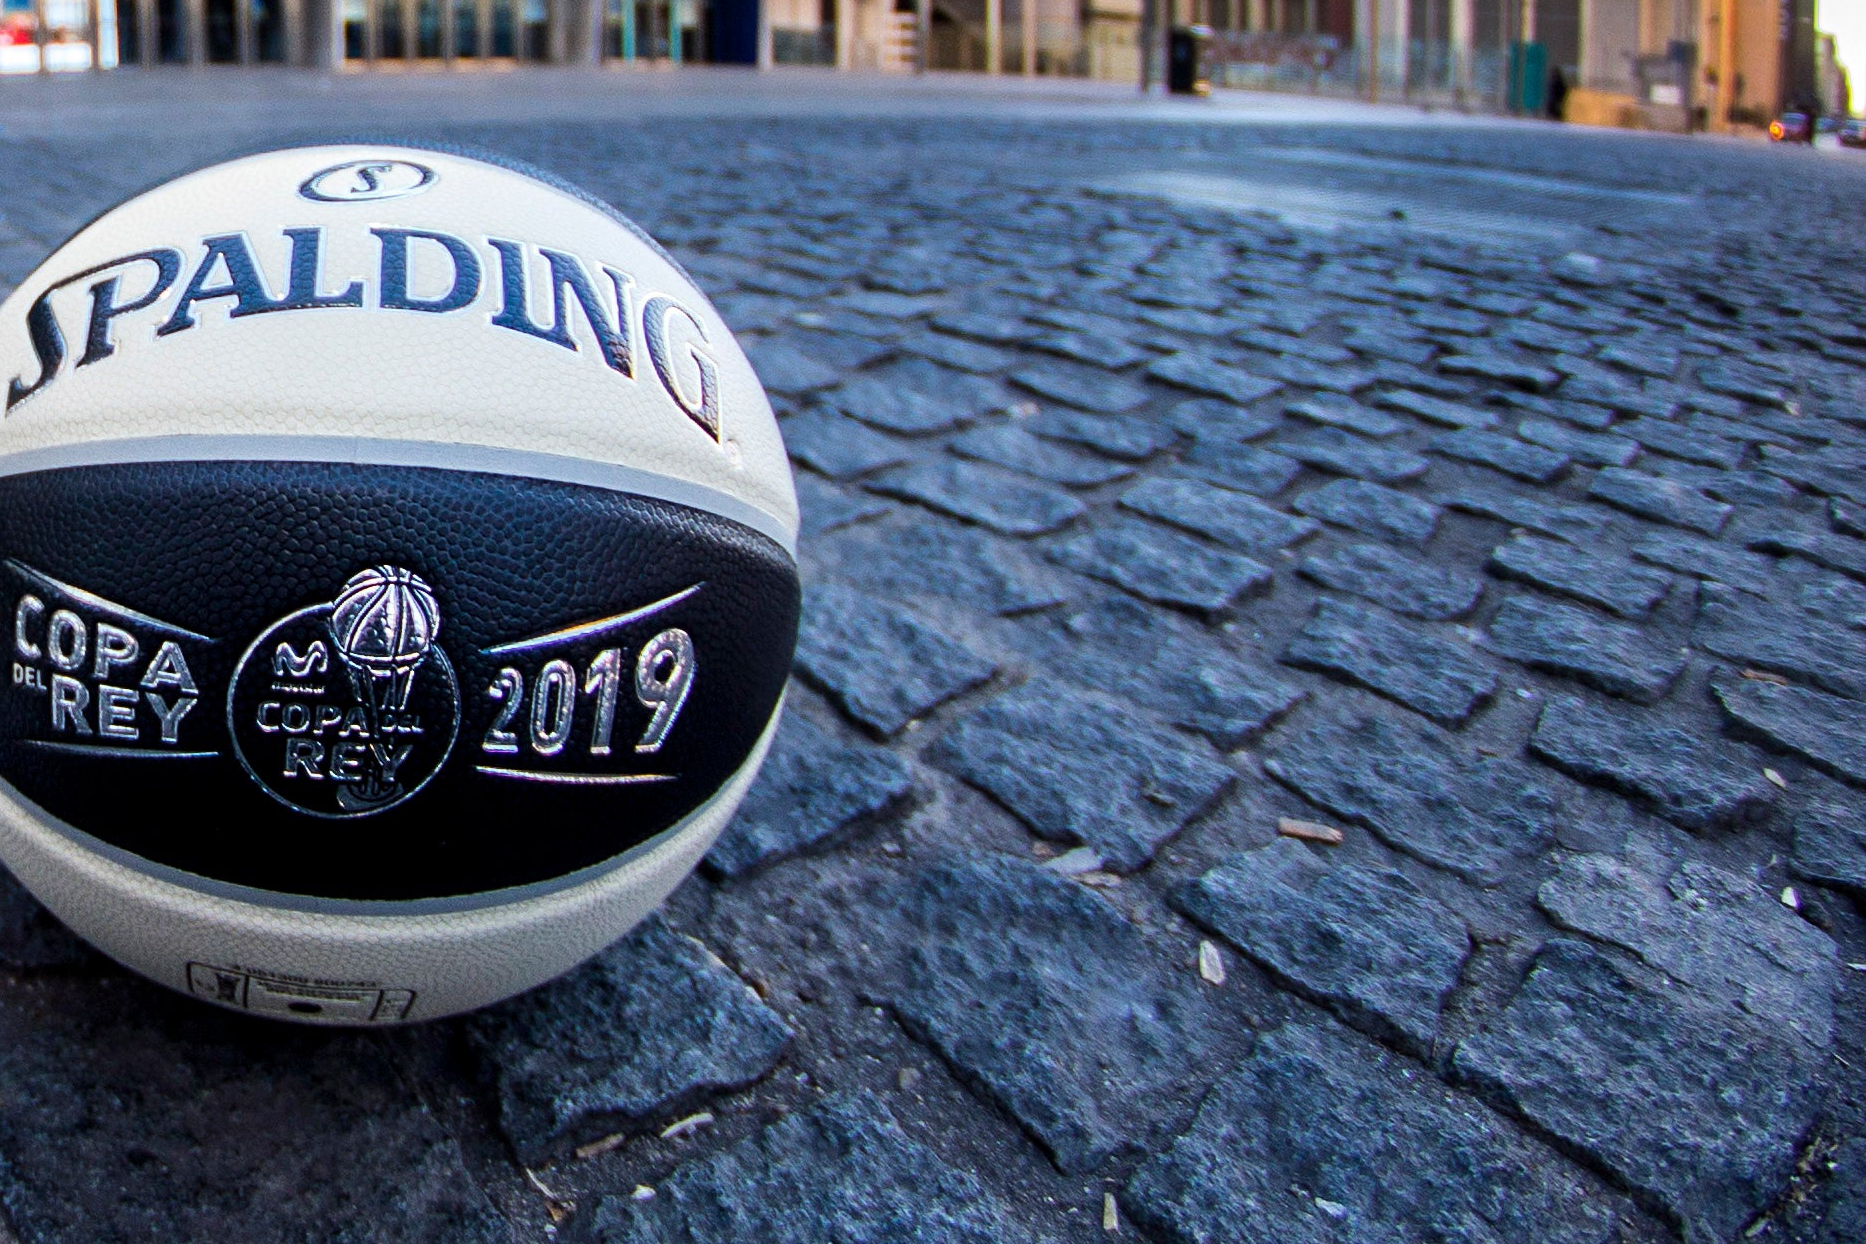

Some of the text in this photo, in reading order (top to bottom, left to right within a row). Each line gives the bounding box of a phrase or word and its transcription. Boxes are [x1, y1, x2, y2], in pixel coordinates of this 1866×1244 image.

[5, 226, 721, 446] SPALDING
[12, 661, 48, 691] DEL
[15, 593, 200, 697] COPA
[51, 672, 199, 744] REY
[256, 701, 371, 737] COPA
[482, 627, 696, 756] 2019
[283, 737, 414, 783] REY
